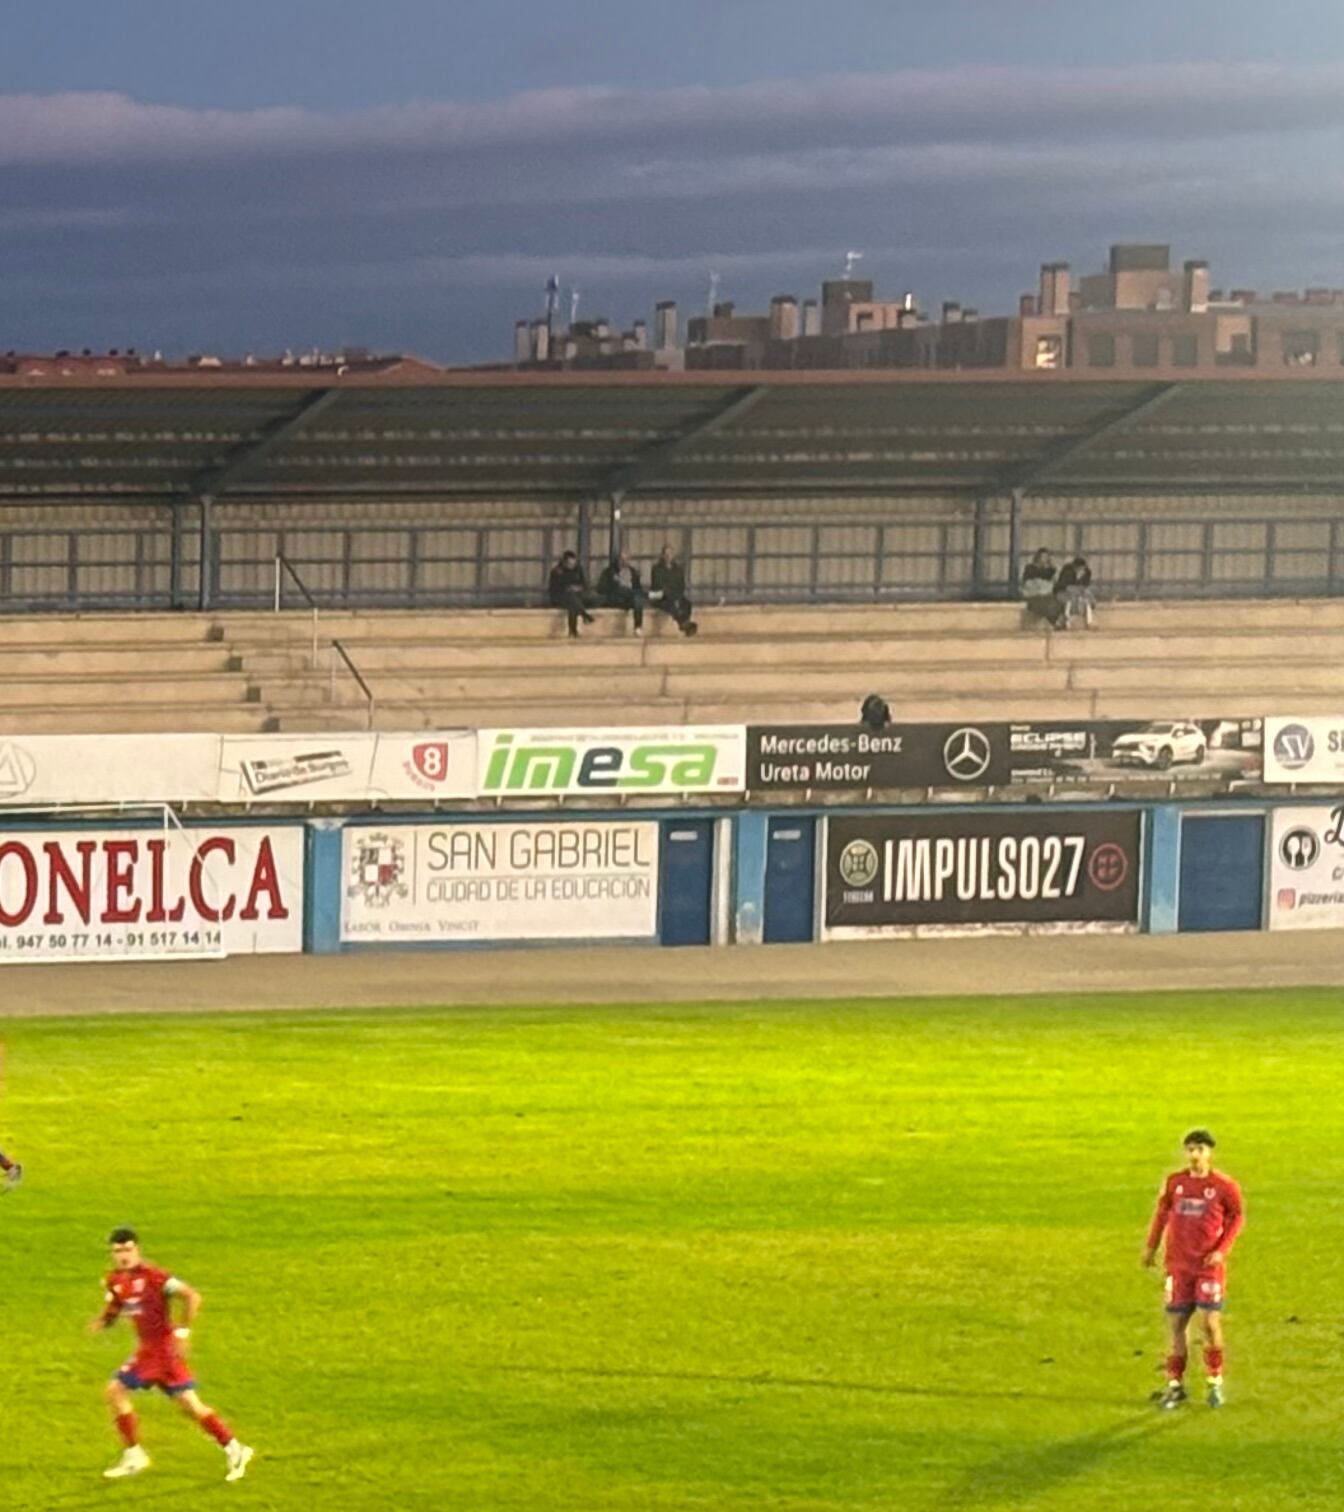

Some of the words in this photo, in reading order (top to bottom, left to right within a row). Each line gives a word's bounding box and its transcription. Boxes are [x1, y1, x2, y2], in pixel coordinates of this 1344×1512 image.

[761, 734, 902, 754] Mercedes-Benz
[423, 747, 442, 776] 8
[483, 734, 717, 790] imesa
[761, 764, 810, 782] Ureta
[815, 762, 871, 780] Motor
[427, 831, 496, 871] SAN
[509, 828, 650, 869] GABRIEL
[883, 836, 1086, 902] IMPULSO27
[427, 880, 490, 902] CIUDAD
[496, 880, 518, 900] DE
[525, 879, 546, 900] LA
[552, 875, 650, 900] EDUCACIÓN
[17, 935, 43, 948] 947
[48, 934, 66, 948] 50
[71, 934, 90, 947] 77
[95, 933, 112, 947] 14
[127, 932, 144, 946] 91
[150, 932, 176, 946] 517
[182, 931, 200, 945] 14
[206, 931, 221, 945] 14
